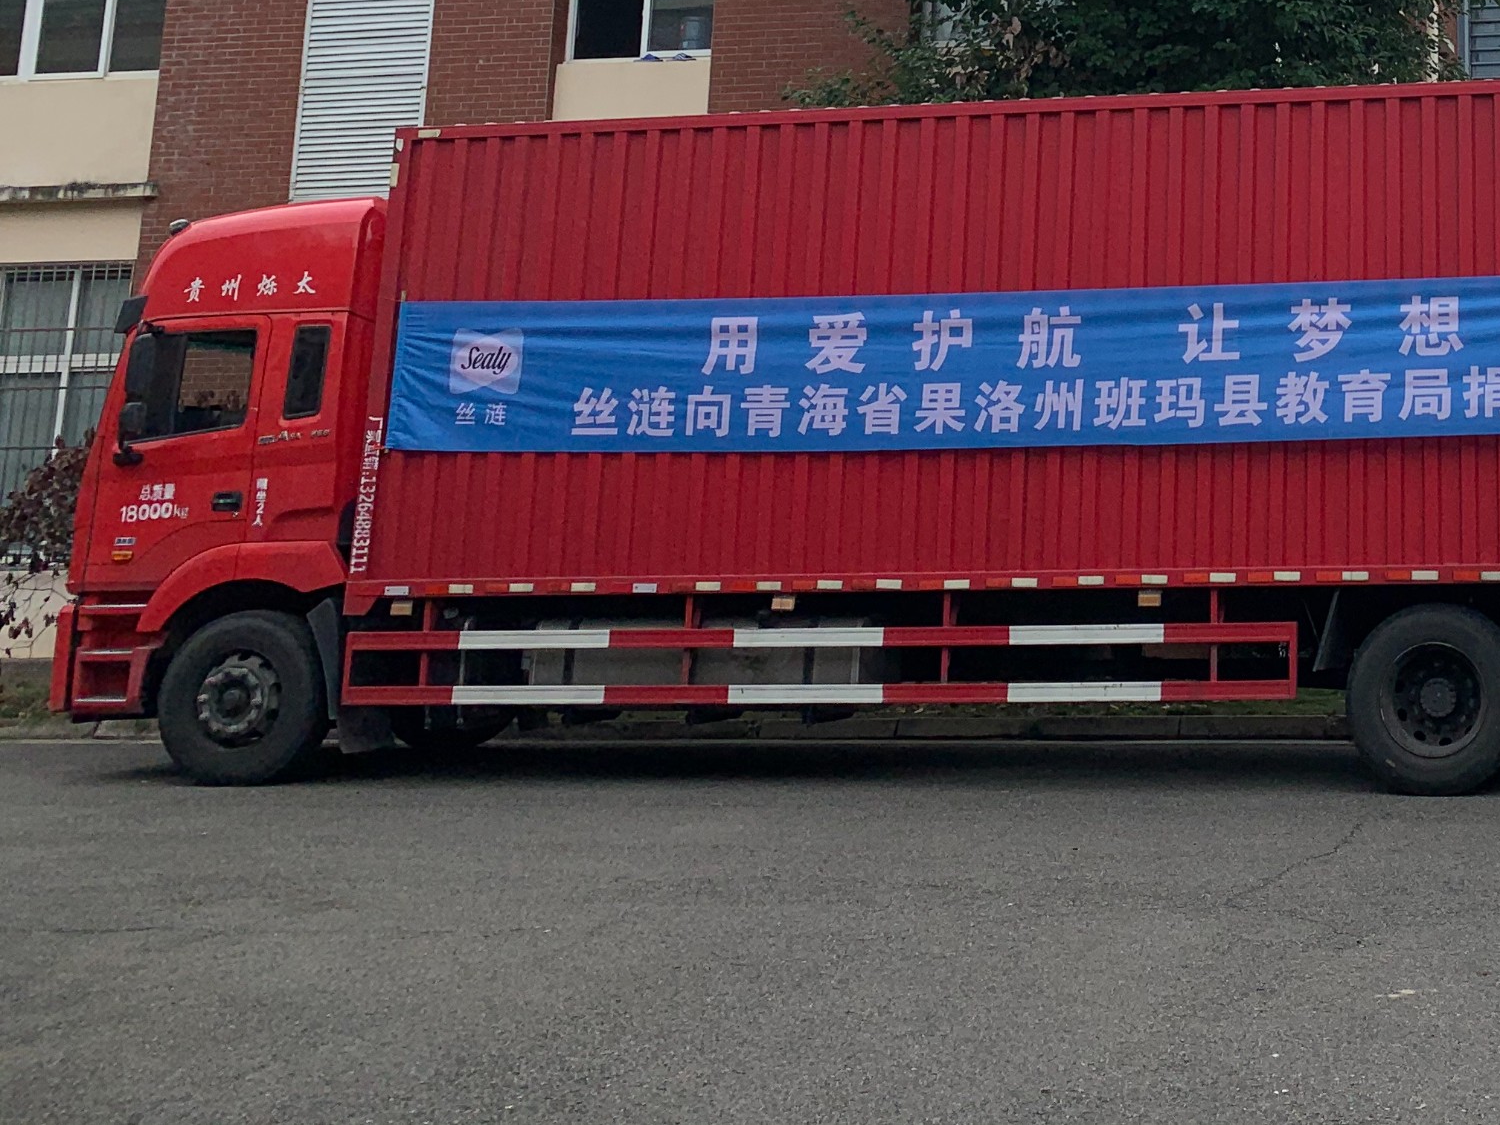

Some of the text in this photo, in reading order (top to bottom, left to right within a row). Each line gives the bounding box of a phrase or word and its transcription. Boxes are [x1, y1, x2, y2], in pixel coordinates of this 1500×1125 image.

[702, 306, 1081, 375] 用爱护航
[460, 346, 512, 375] Sealy
[455, 402, 507, 425] 丝涟
